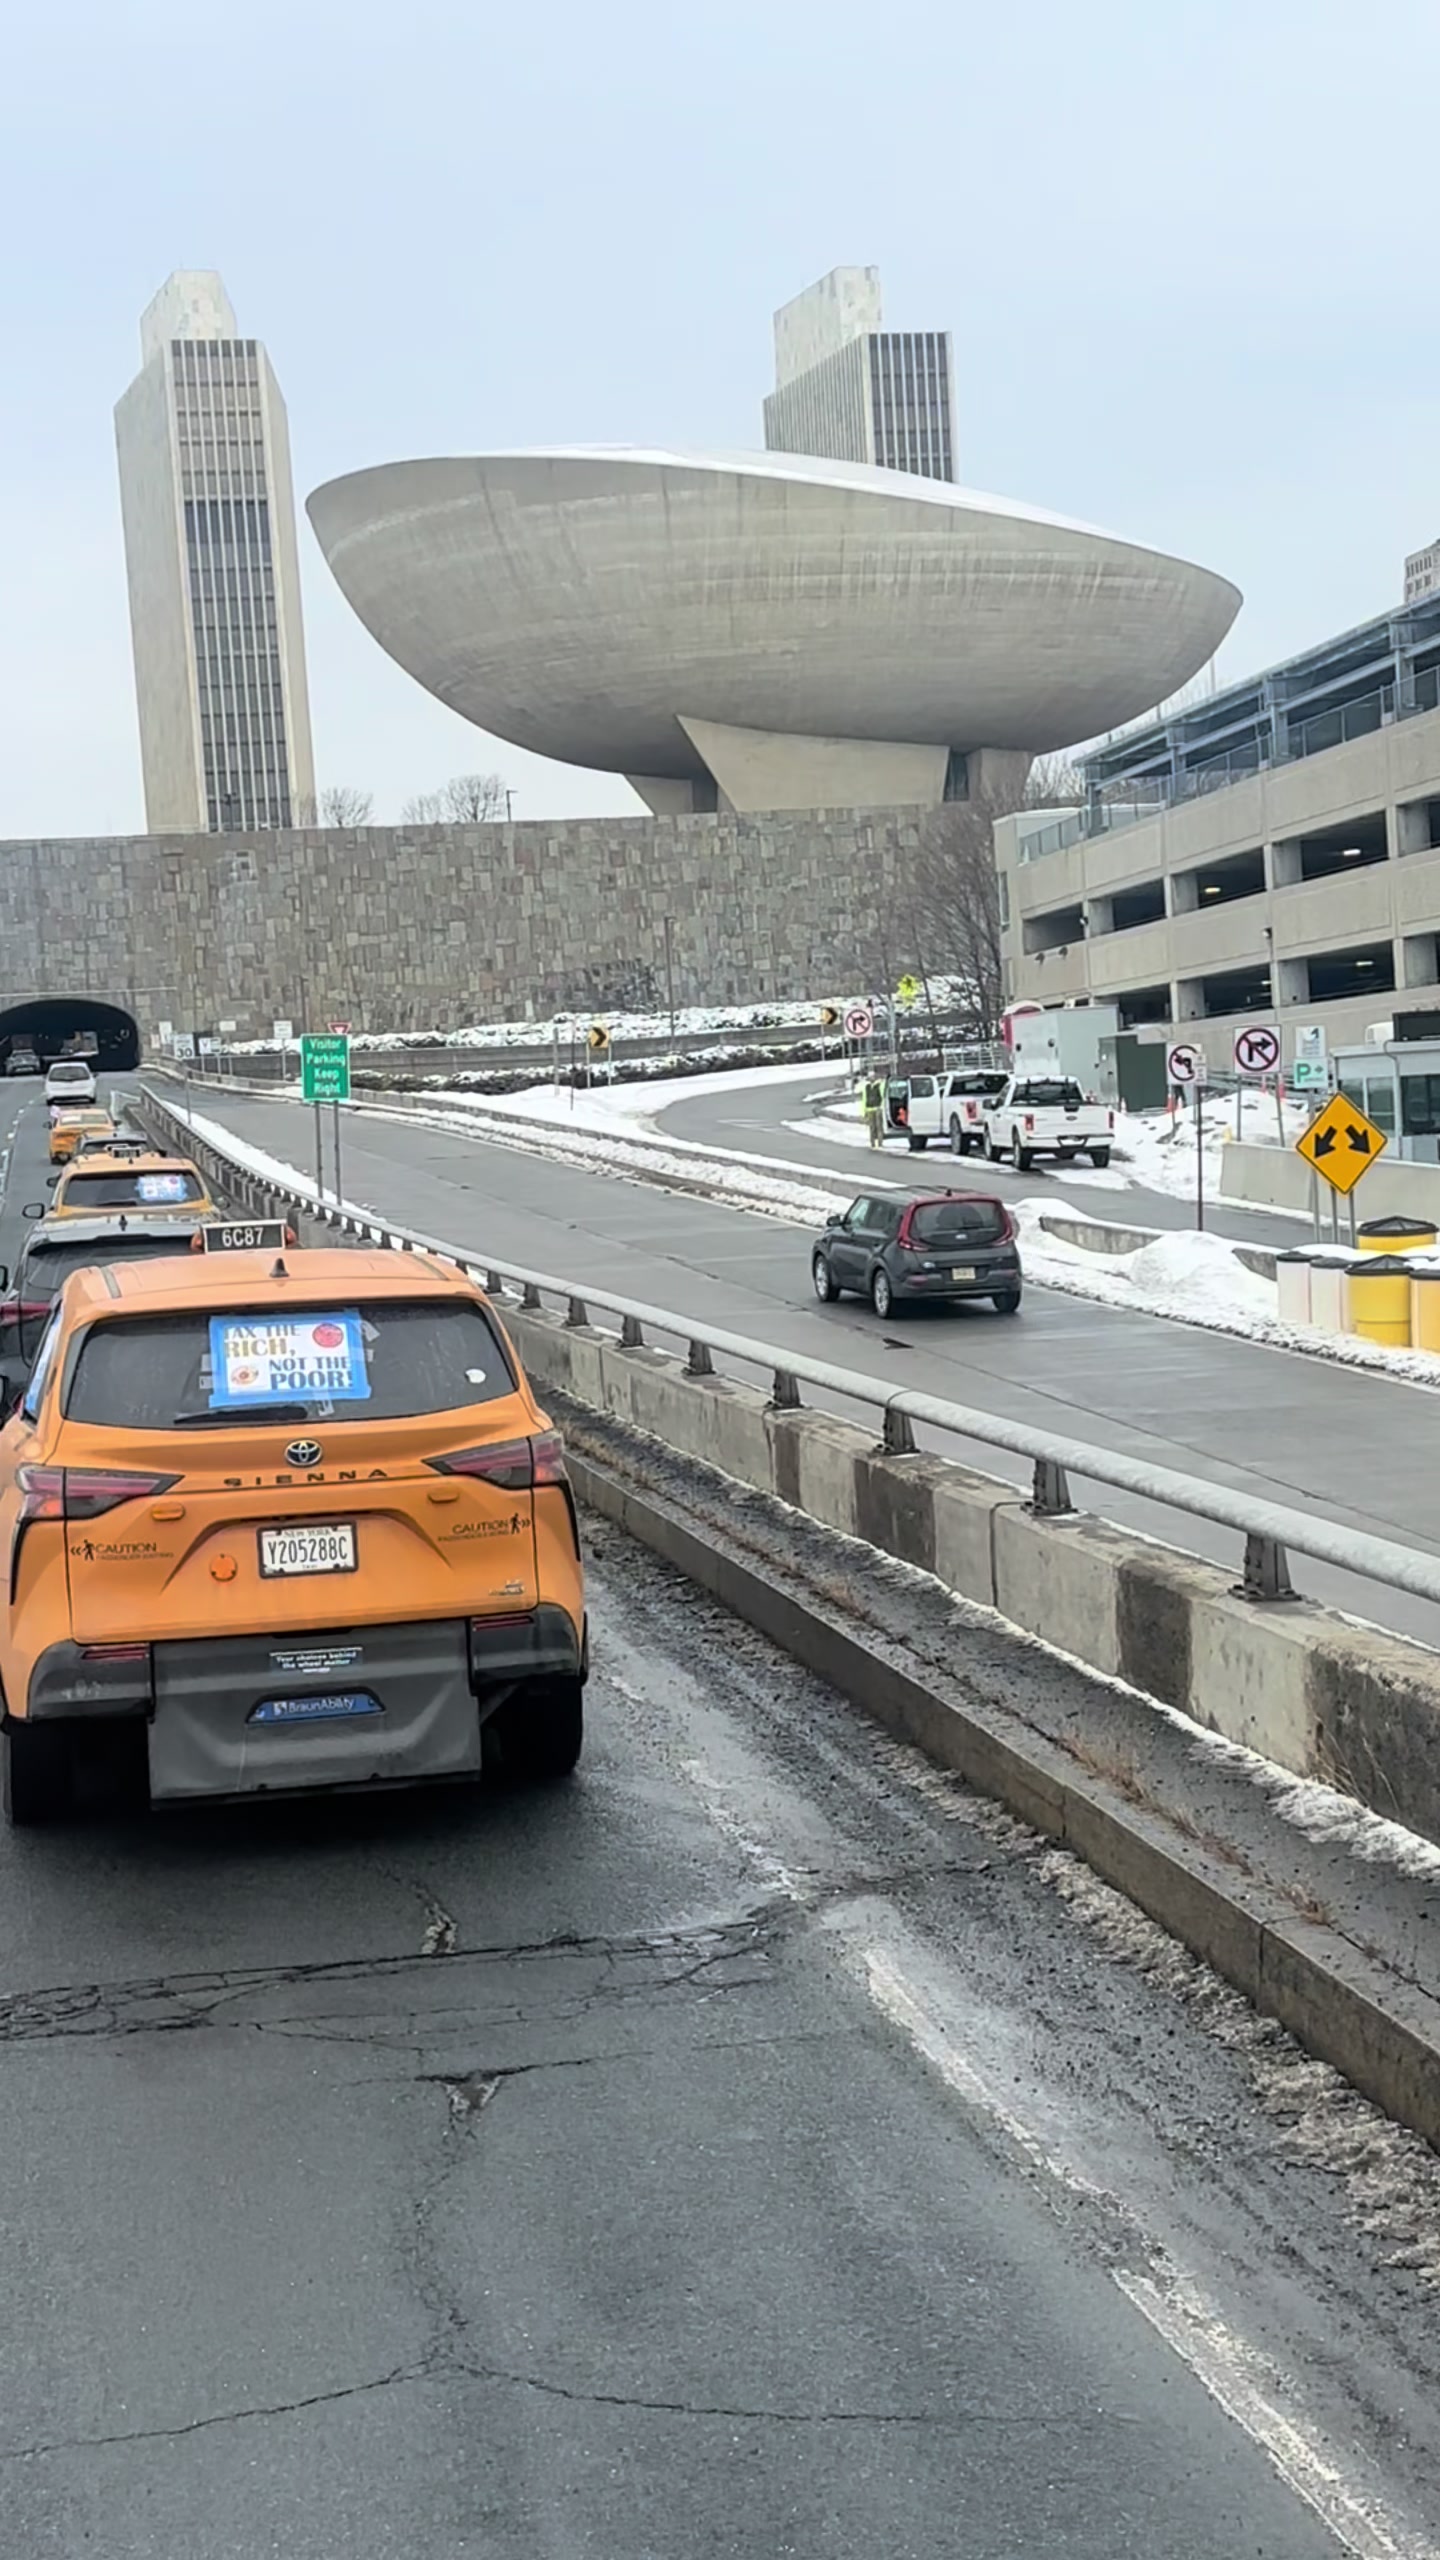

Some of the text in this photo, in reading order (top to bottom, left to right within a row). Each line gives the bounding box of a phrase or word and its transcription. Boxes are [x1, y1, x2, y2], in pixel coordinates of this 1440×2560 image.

[309, 1038, 341, 1049] Visitor
[177, 1047, 193, 1058] 30
[306, 1052, 345, 1067] Parking
[314, 1067, 339, 1080] Keep
[1296, 1063, 1311, 1083] P
[314, 1081, 340, 1096] Right
[221, 1226, 264, 1247] 6C87
[223, 1324, 302, 1340] TAX THE
[223, 1338, 296, 1358] RICH,
[269, 1356, 350, 1371] NOT THE
[270, 1370, 353, 1390] POOR!
[223, 1468, 388, 1487] SIENNA
[452, 1519, 508, 1534] CAUTION
[95, 1542, 157, 1554] CAUTION
[267, 1536, 348, 1565] Y205288C
[289, 1698, 354, 1712] BraunAbility
